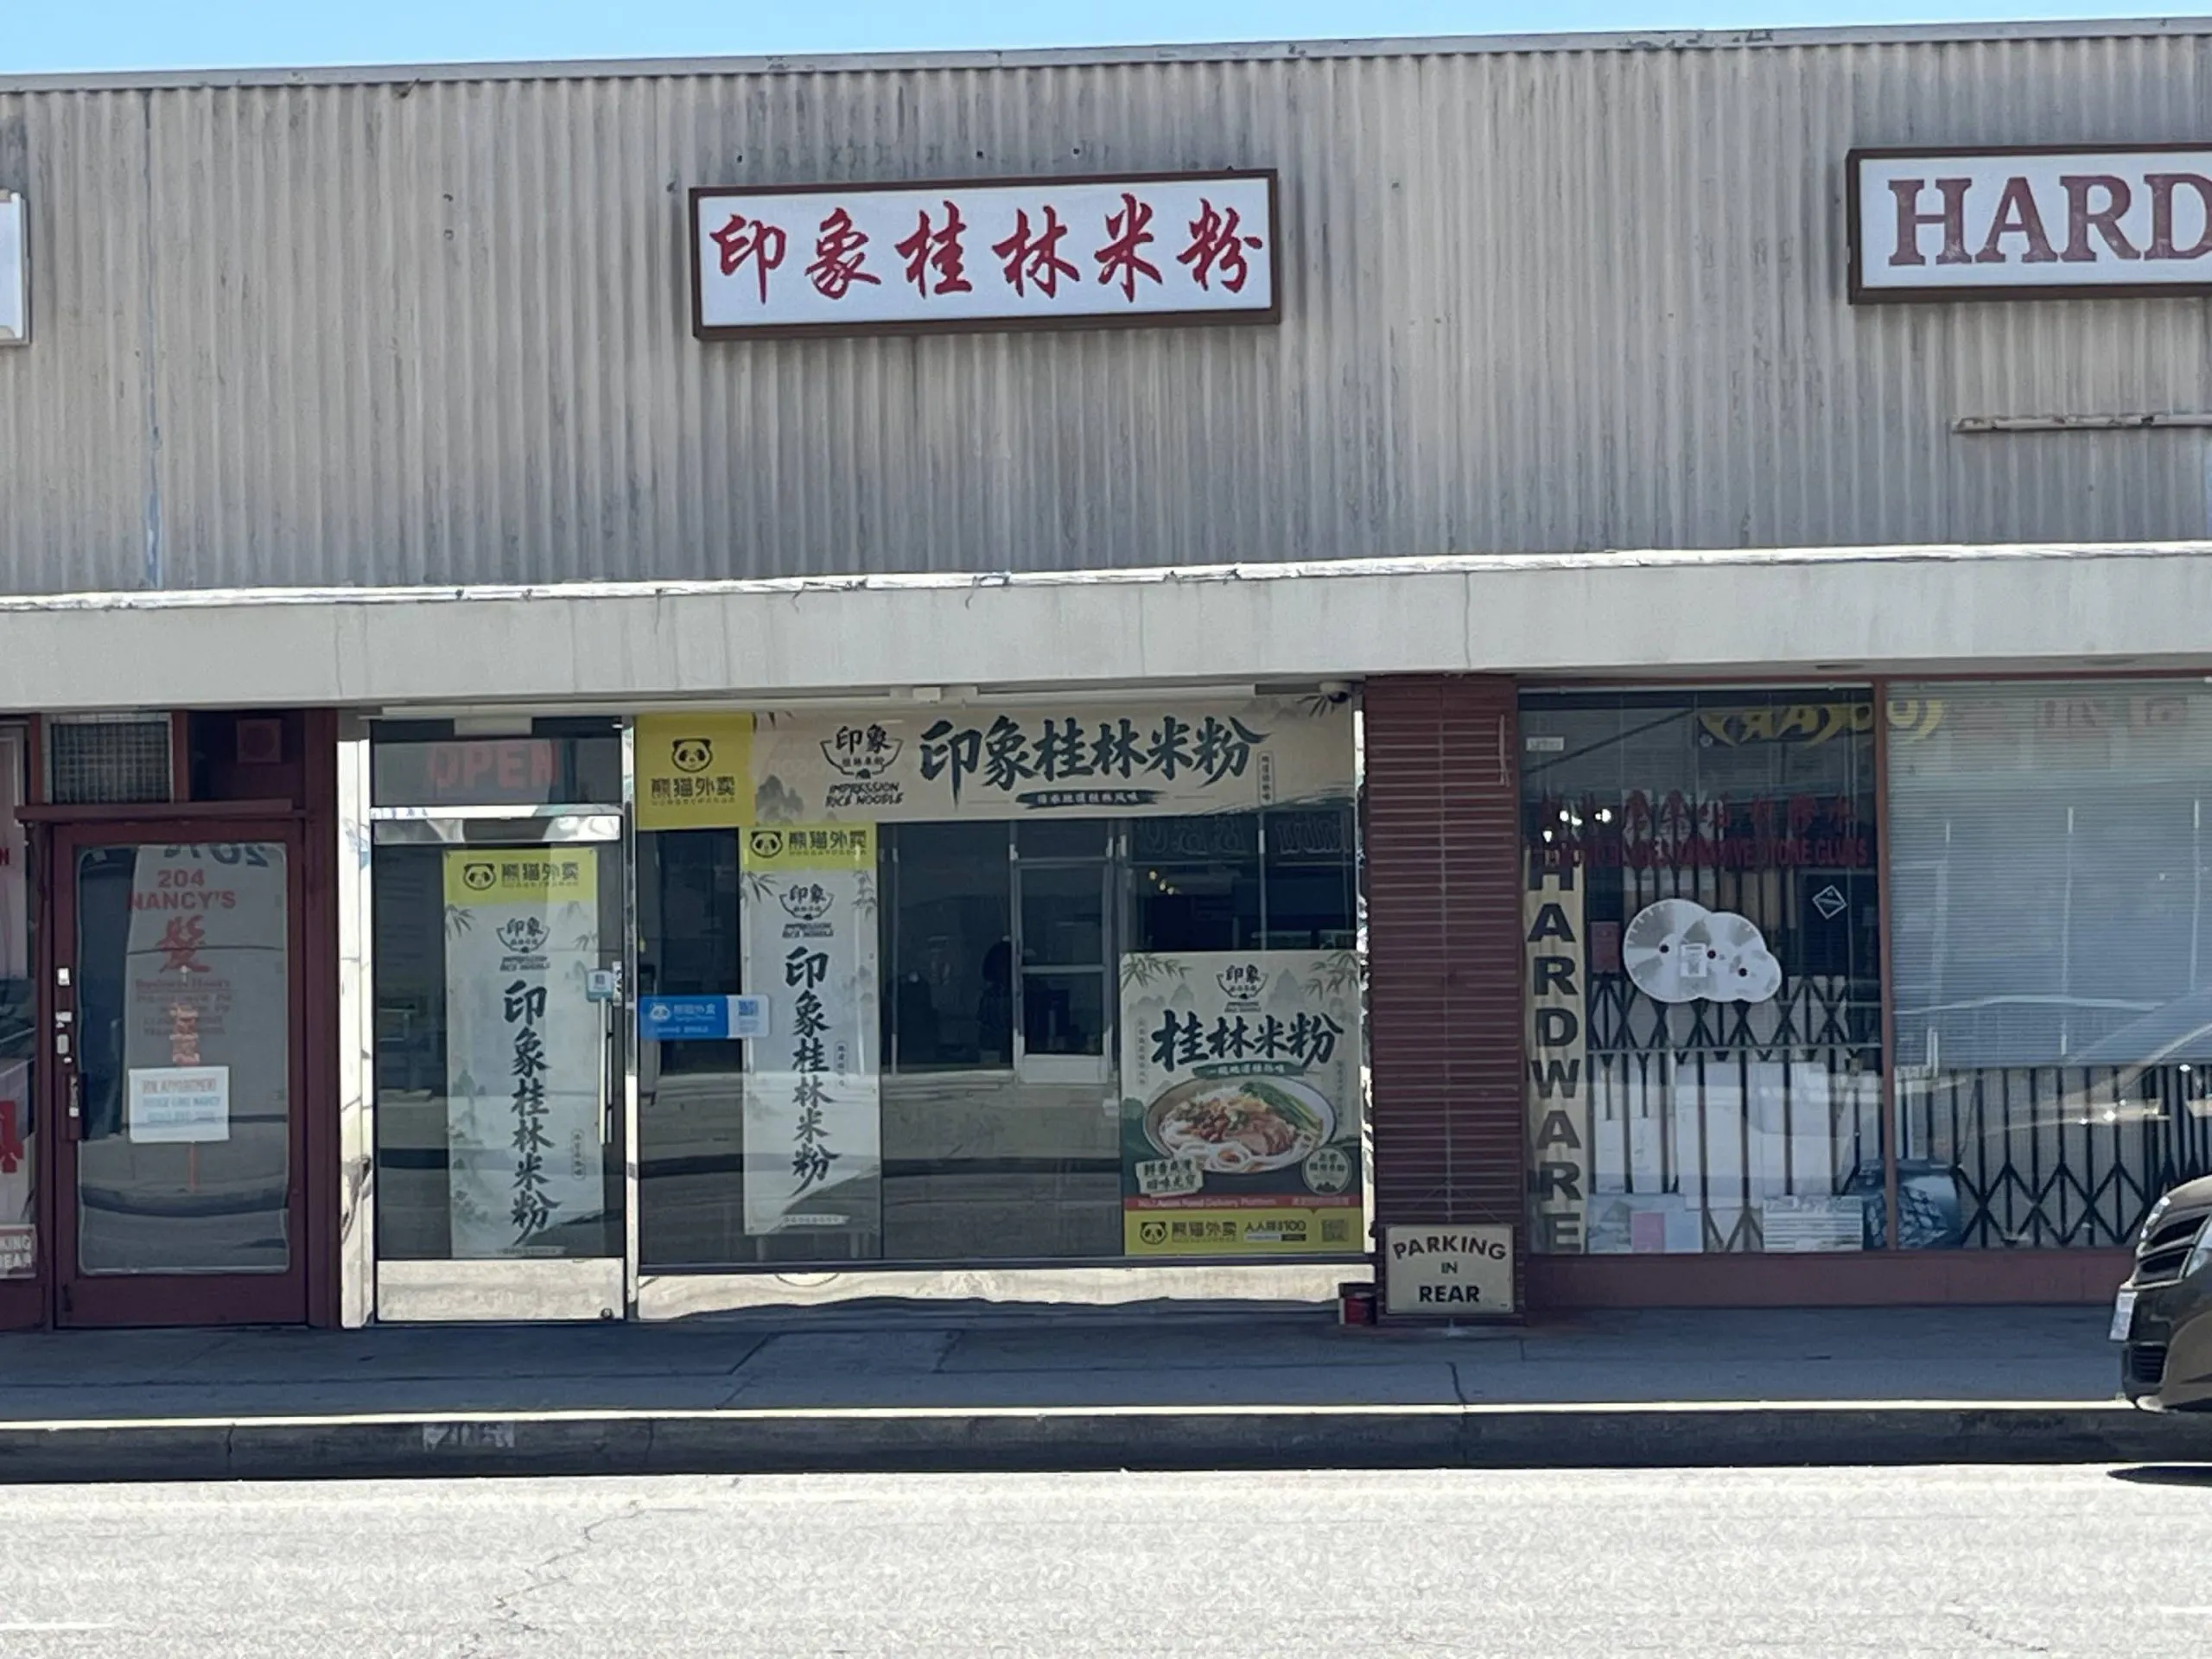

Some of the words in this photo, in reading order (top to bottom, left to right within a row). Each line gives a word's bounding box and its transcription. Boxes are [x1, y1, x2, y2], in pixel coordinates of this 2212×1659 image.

[1888, 174, 2212, 265] HARD
[709, 193, 1262, 304] 印象桂林米粉
[835, 724, 892, 753] 印象
[919, 715, 1271, 810] 印象桂林米粉
[651, 777, 735, 797] 熊猫外卖
[157, 869, 205, 888] 204
[127, 890, 236, 910] NANCY'S
[790, 883, 827, 904] 印象
[506, 917, 543, 937] 印象
[1226, 963, 1262, 983] 印象
[1151, 1009, 1344, 1072] 桂林米粉
[1527, 849, 1583, 1252] HARDWARE
[785, 946, 842, 1198] 印象桂林米粉
[504, 980, 563, 1246] 印象桂林米粉
[1392, 1235, 1506, 1260] PARKING
[1440, 1262, 1458, 1274] IN
[1419, 1285, 1479, 1303] REAR
